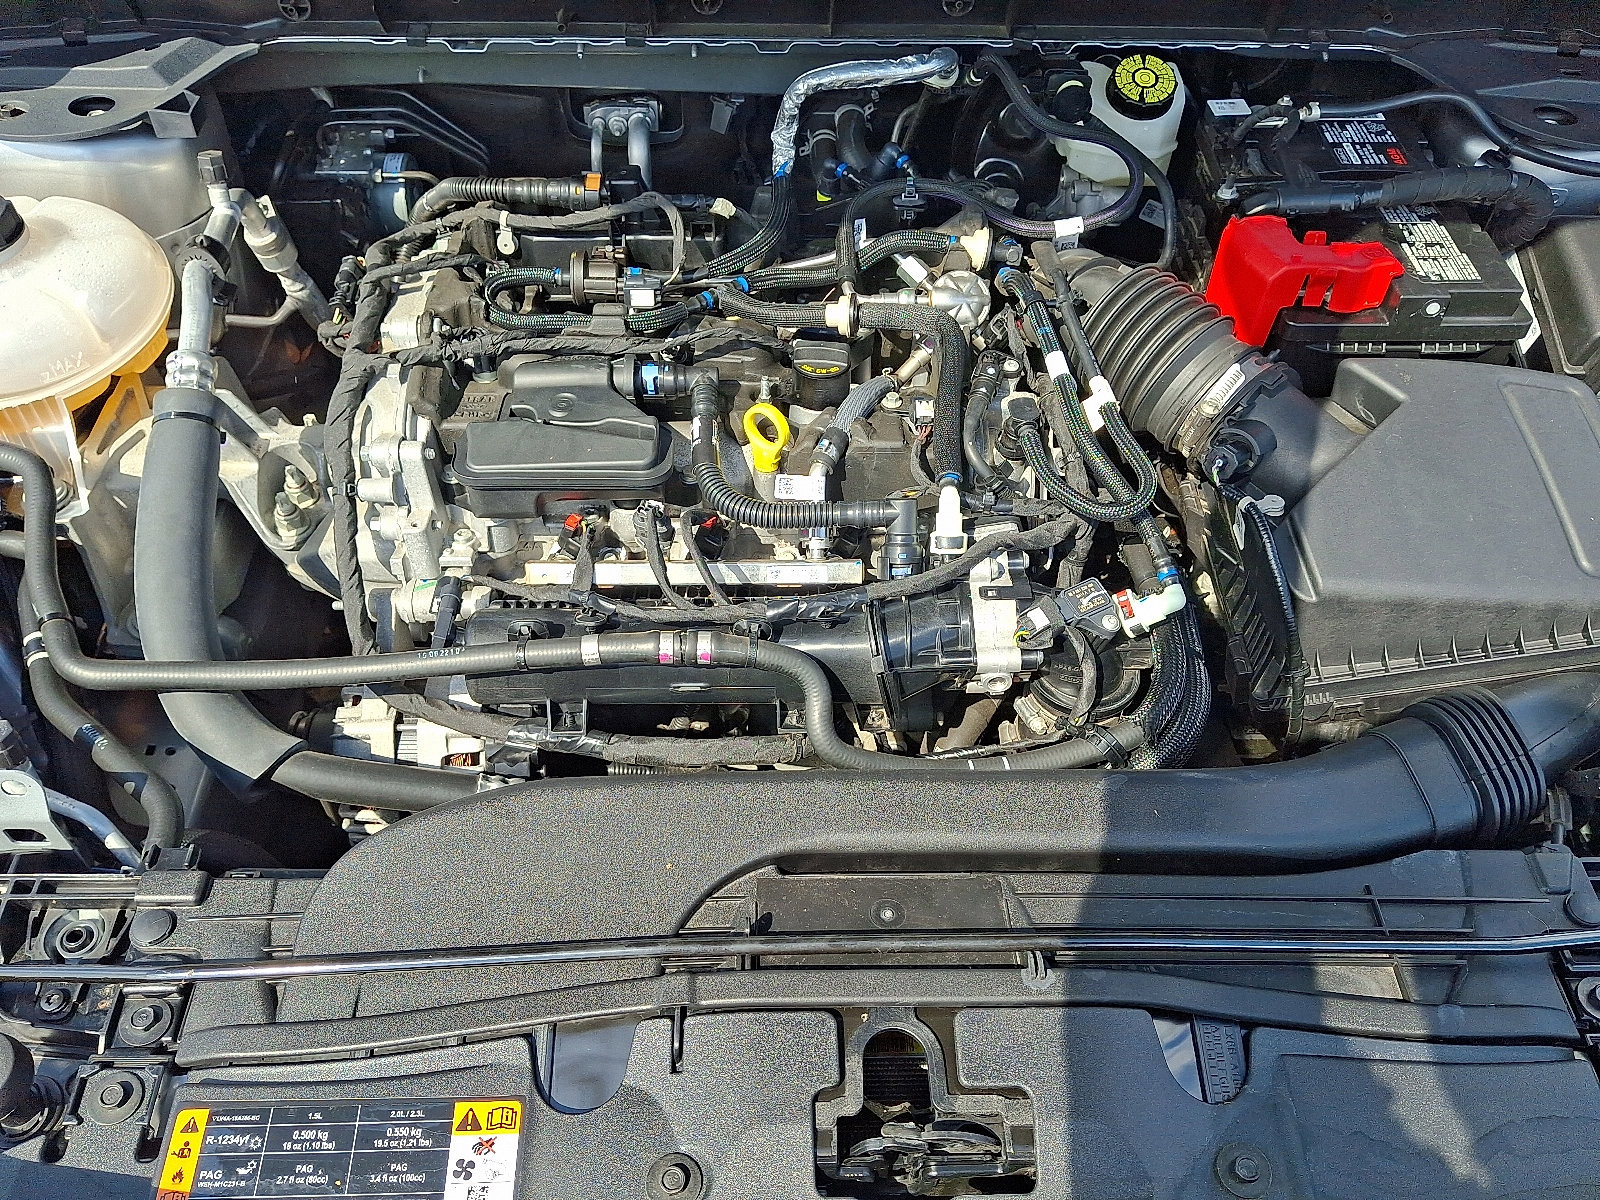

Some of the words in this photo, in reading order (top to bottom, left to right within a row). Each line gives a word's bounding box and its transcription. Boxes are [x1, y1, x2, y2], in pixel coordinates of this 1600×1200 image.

[1386, 147, 1404, 165] AGM
[308, 1112, 323, 1120] 1.5L
[292, 1129, 316, 1140] 0.500
[317, 1129, 329, 1142] kg
[386, 1126, 410, 1137] 0.550
[411, 1126, 423, 1138] kg
[292, 1143, 302, 1151] oz
[302, 1141, 321, 1152] (1.10
[321, 1140, 336, 1150] lbs)
[389, 1139, 399, 1147] oz
[418, 1137, 432, 1148] lbs)
[295, 1165, 314, 1173] PAG
[390, 1163, 408, 1173] PAG
[199, 1170, 223, 1180] PAG
[369, 1174, 381, 1183] 3.4
[388, 1174, 400, 1183] oz
[399, 1173, 426, 1183] (100cc)
[275, 1176, 288, 1185] 2.7
[295, 1176, 305, 1184] oz
